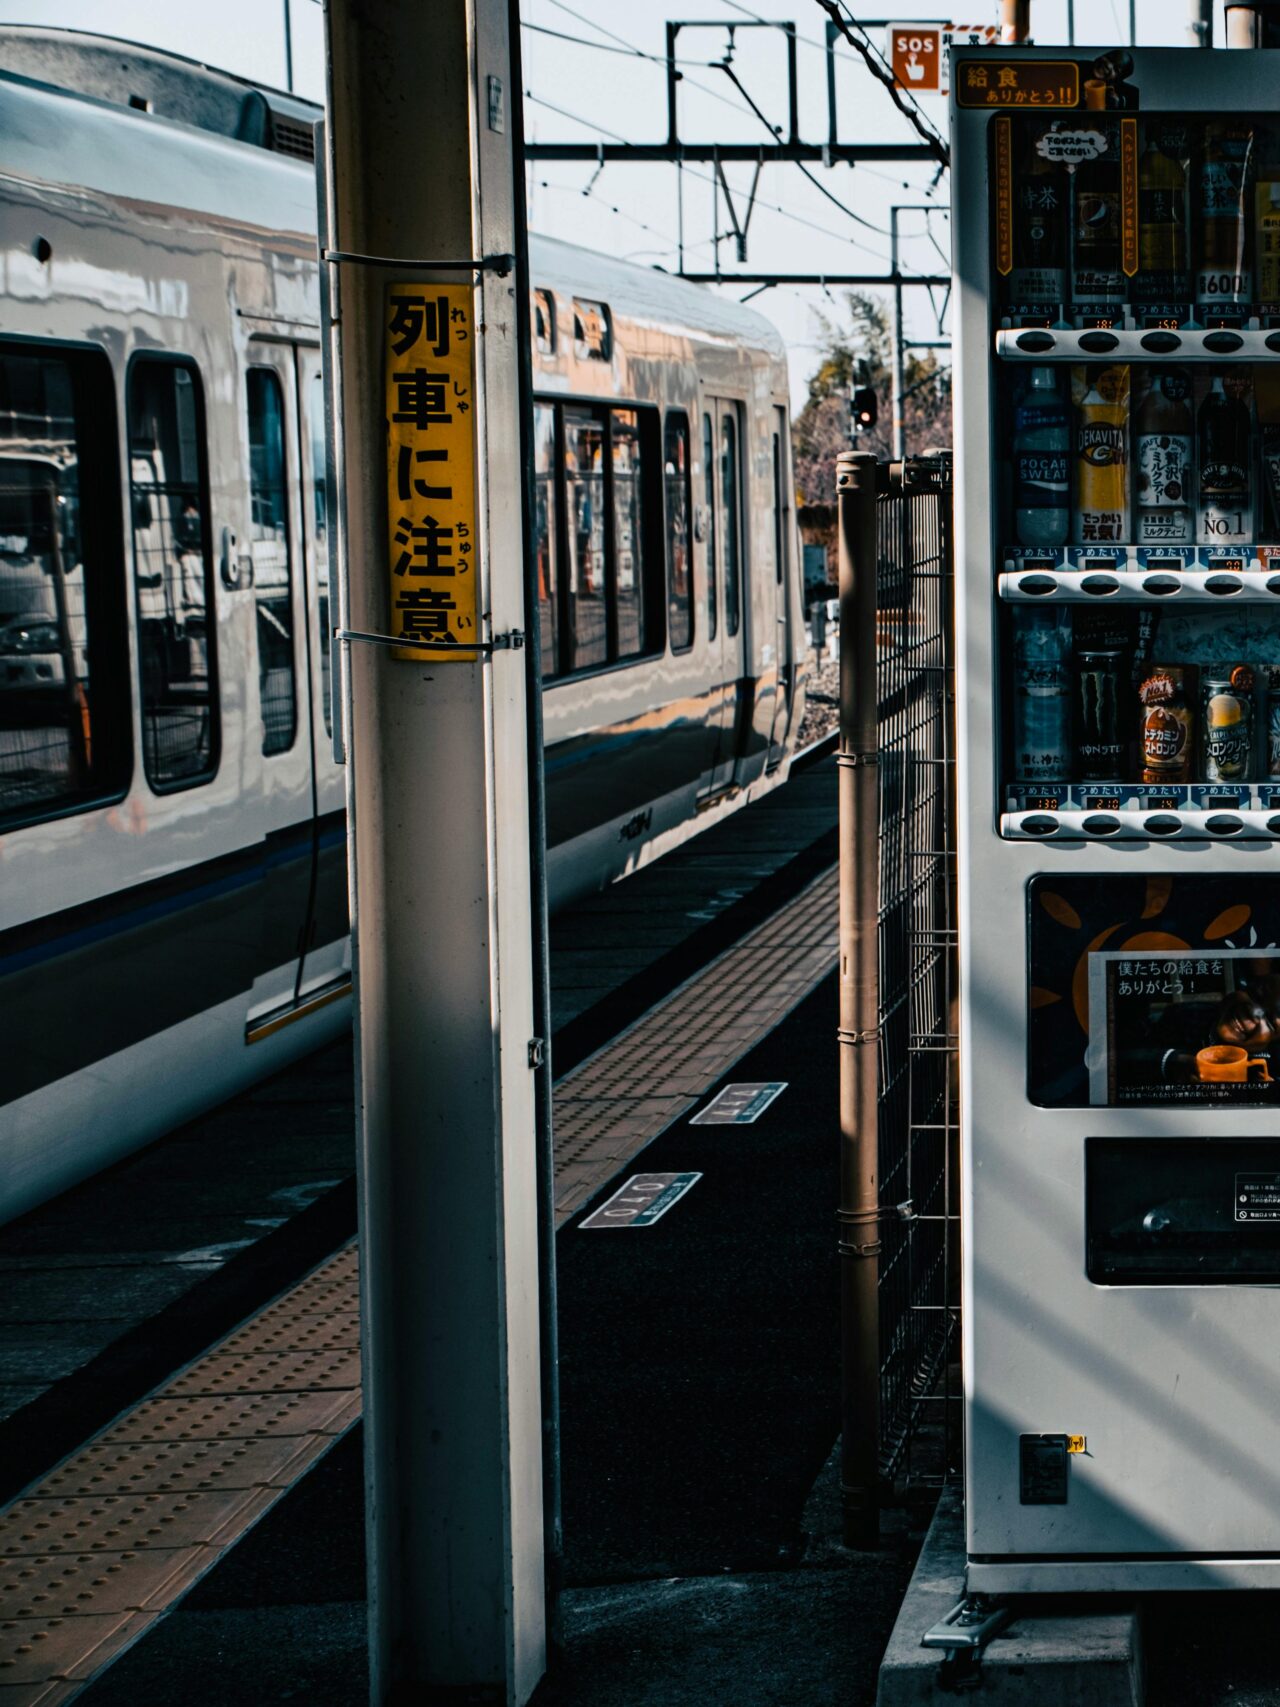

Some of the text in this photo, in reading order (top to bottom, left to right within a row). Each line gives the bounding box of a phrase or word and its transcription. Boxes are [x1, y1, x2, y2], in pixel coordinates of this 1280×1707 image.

[897, 37, 934, 53] SOS
[967, 66, 1018, 88] 給食
[1008, 305, 1053, 314] つめたい
[1070, 305, 1115, 314] つめたい
[1138, 305, 1183, 314] つめたい
[1200, 305, 1245, 314] つめたい
[1078, 429, 1124, 451] DEKAVITA
[388, 294, 460, 645] 列車に注意
[1020, 459, 1069, 470] POCAR
[1020, 469, 1068, 481] SWEAT
[1152, 452, 1165, 504] ミルクティー
[1082, 513, 1122, 524] でっかい
[1204, 512, 1246, 536] NO.1
[1013, 548, 1058, 557] つめたい
[1075, 548, 1120, 557] つめたい
[1143, 548, 1188, 557] つめたい
[1205, 548, 1250, 557] つめたい
[1205, 740, 1251, 757] メロンクリーム
[1017, 786, 1062, 795] つめたい
[1078, 786, 1123, 795] つめたい
[1137, 786, 1182, 795] つめたい
[1198, 786, 1243, 795] つめたい
[1117, 959, 1224, 977] 僕たちの給食を
[1117, 981, 1197, 996] ありがとう！
